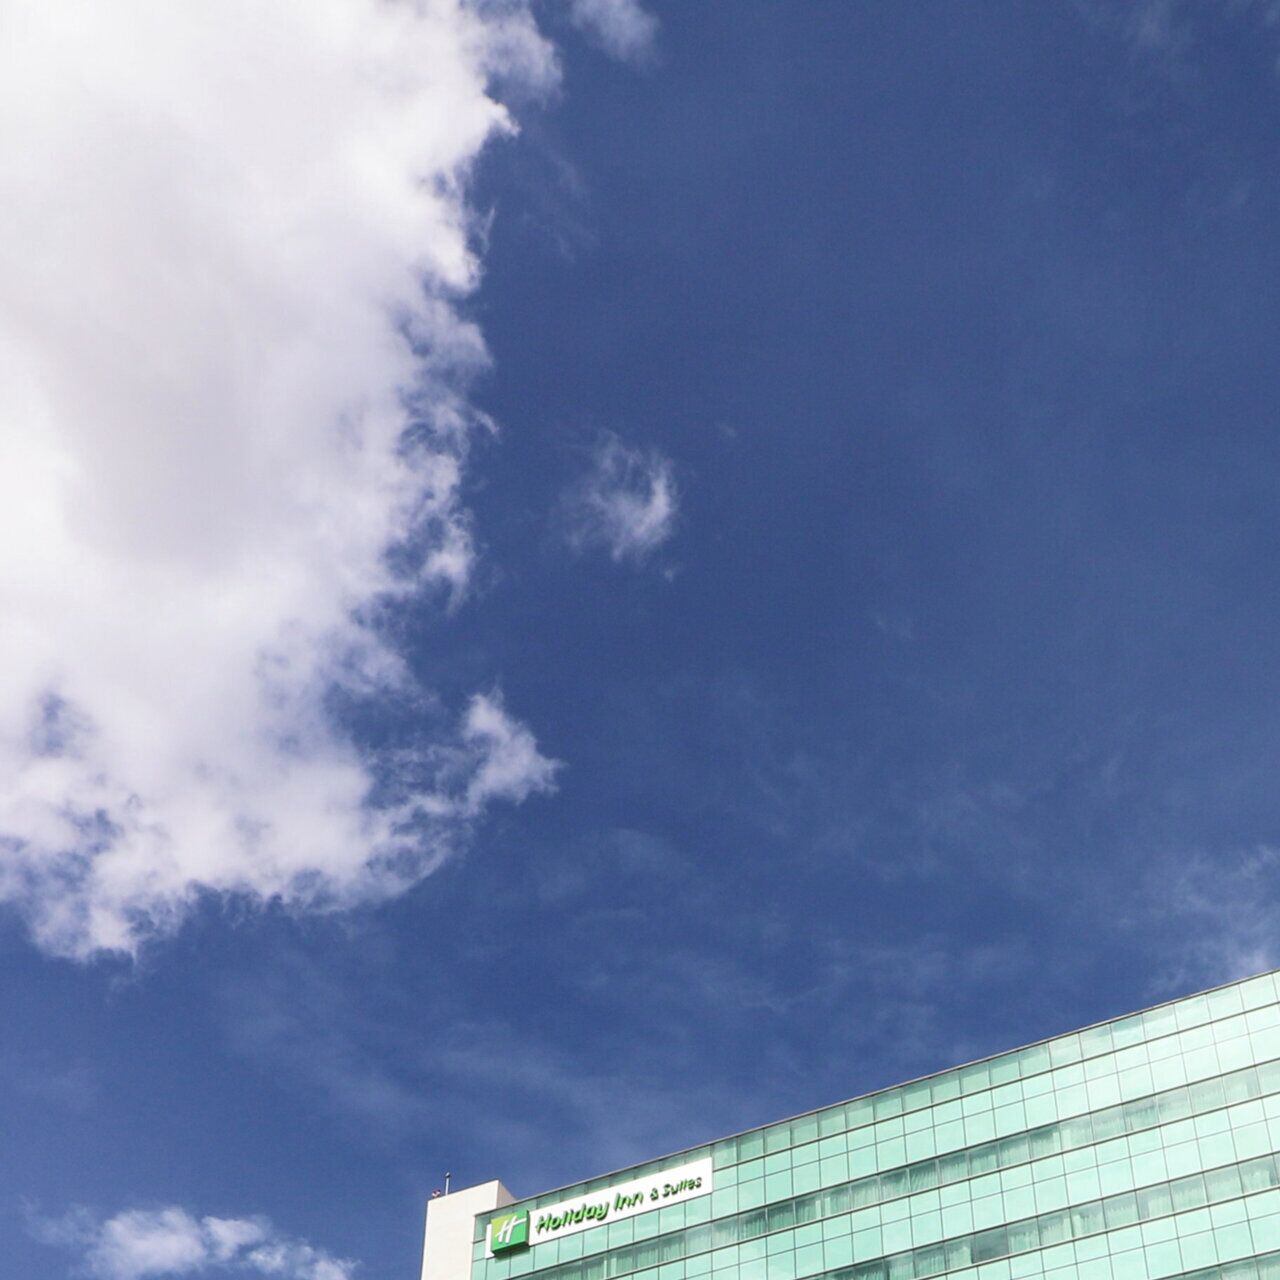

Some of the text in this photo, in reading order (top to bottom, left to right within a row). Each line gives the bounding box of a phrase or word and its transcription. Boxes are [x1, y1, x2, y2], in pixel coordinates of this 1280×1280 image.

[535, 1201, 609, 1234] Holiday
[613, 1191, 643, 1212] Inn
[662, 1176, 702, 1198] Suites
